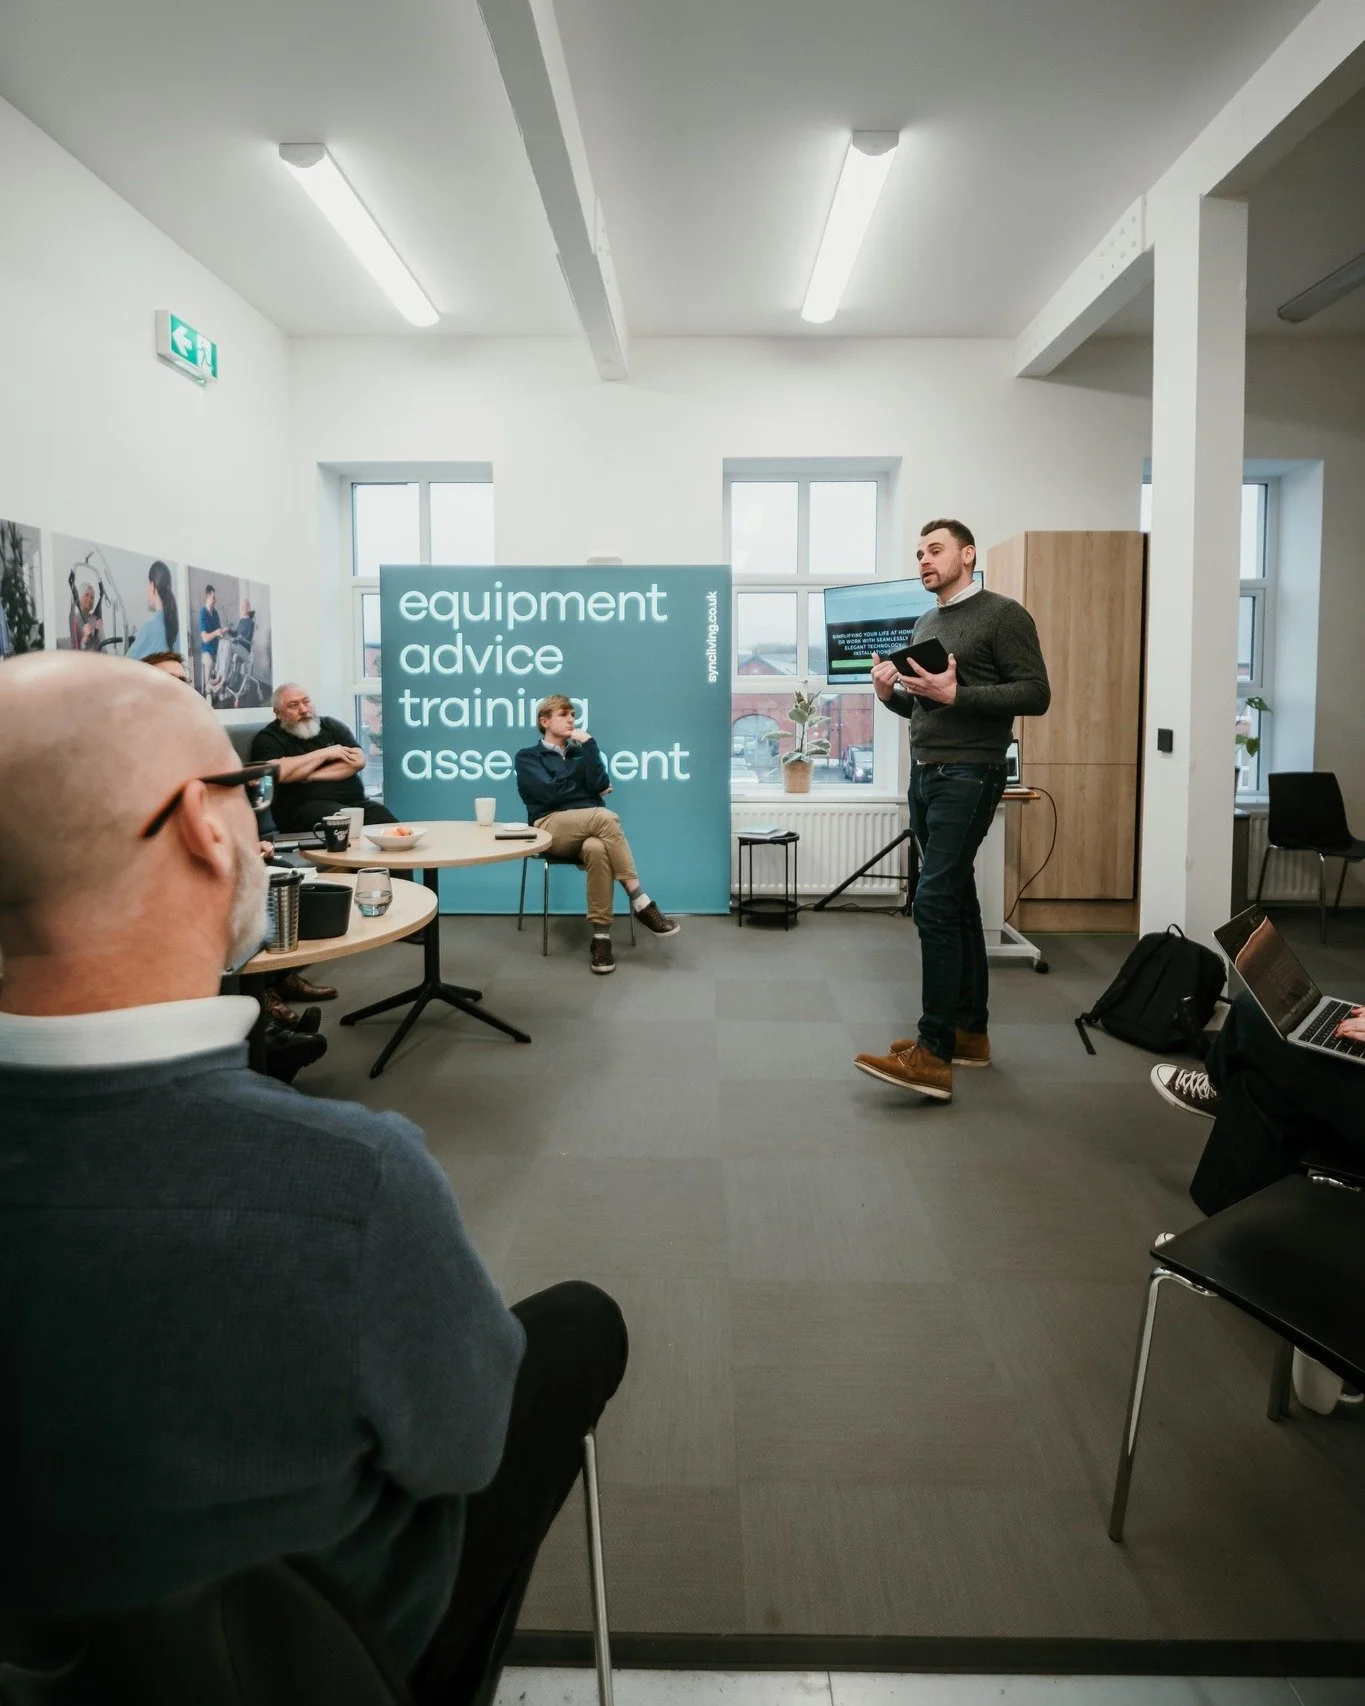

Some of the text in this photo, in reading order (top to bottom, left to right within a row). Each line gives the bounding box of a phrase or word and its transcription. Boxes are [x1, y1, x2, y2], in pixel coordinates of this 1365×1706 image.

[398, 580, 668, 630] equipment
[398, 632, 564, 675] advice
[705, 590, 719, 684] syncliving.co.uk
[401, 742, 691, 780] asseent
